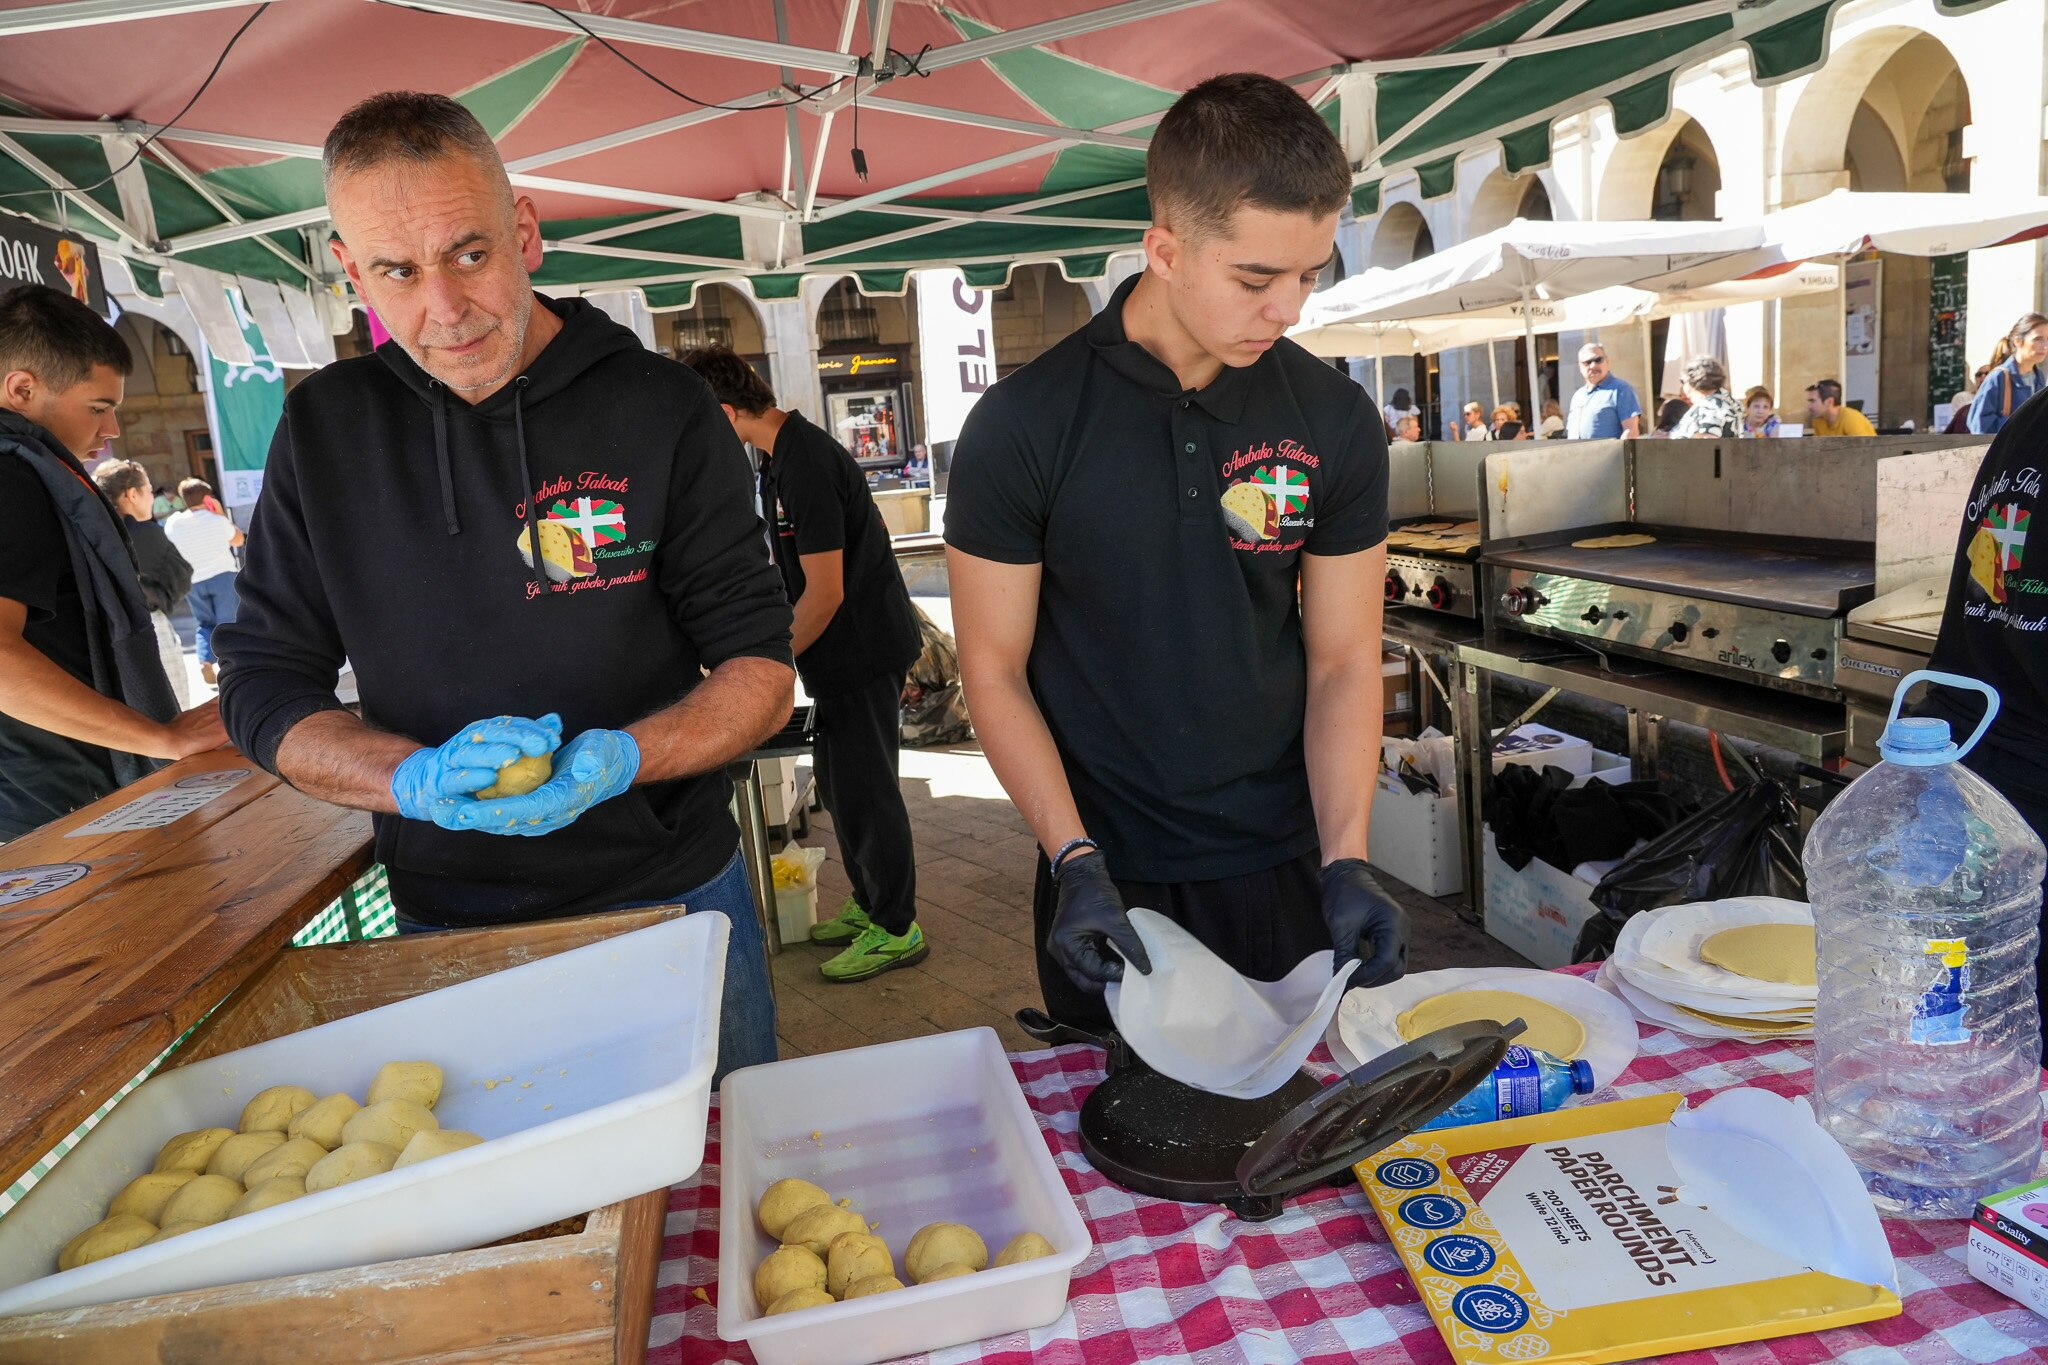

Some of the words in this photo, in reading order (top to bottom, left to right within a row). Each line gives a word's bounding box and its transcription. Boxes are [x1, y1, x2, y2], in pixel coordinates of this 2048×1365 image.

[0, 235, 45, 285] OAK
[1222, 442, 1274, 478] Arabako
[1276, 439, 1320, 469] Taloak
[577, 471, 629, 493] Taloak
[568, 576, 606, 595] gabeko
[1463, 1152, 1498, 1184] STRONG
[1478, 1159, 1509, 1184] EXTRA
[1525, 1191, 1548, 1216] White
[1550, 1226, 1570, 1245] inch
[1542, 1189, 1564, 1208] 200
[1556, 1206, 1592, 1242] SHEETS
[1544, 1146, 1607, 1202] PAPER
[1590, 1201, 1677, 1287] ROUNDS
[1577, 1151, 1698, 1267] PARCHMENT
[1997, 1220, 2032, 1246] Quality
[1456, 1236, 1491, 1272] HEAT-RESISTANT
[1983, 1246, 2000, 1259] 2777
[1502, 1293, 1524, 1320] NATURAL
